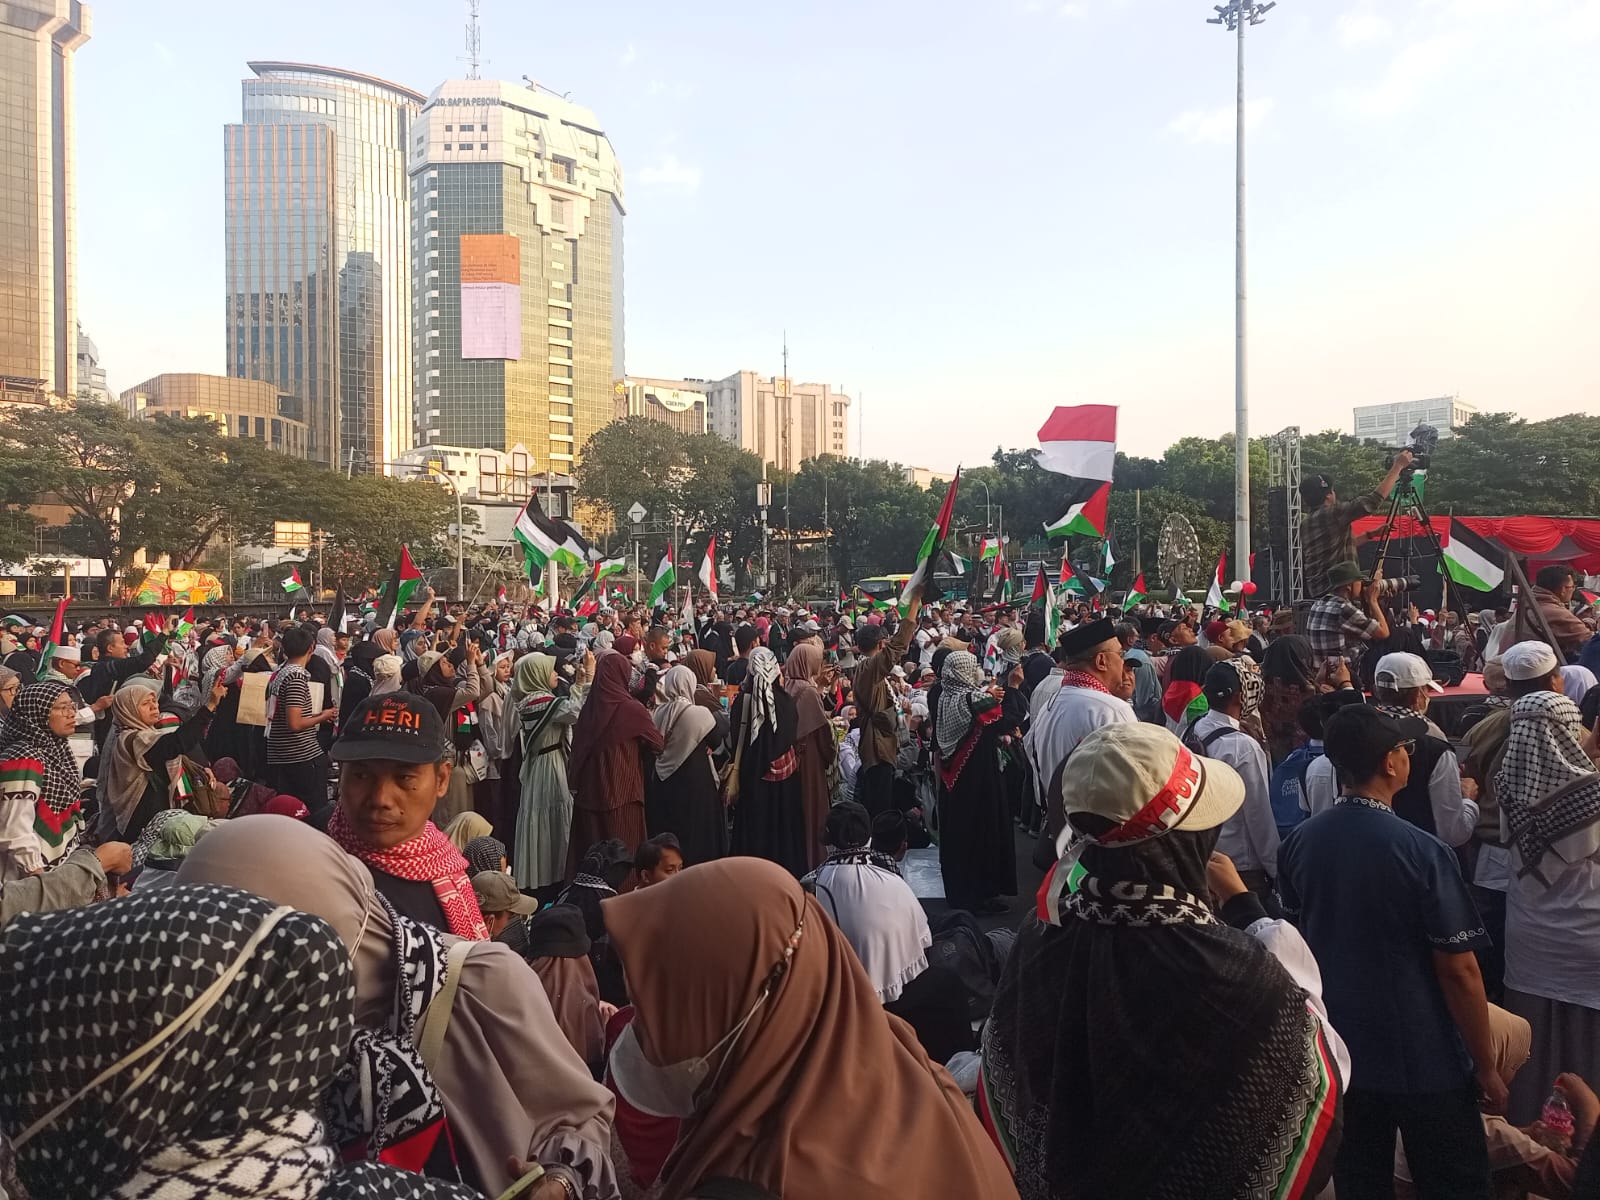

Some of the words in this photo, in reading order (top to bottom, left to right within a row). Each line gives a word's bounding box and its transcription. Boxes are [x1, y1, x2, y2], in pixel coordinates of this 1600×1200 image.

[448, 98, 470, 107] SAPTA
[471, 97, 502, 107] PESONA
[363, 709, 421, 729] HERI
